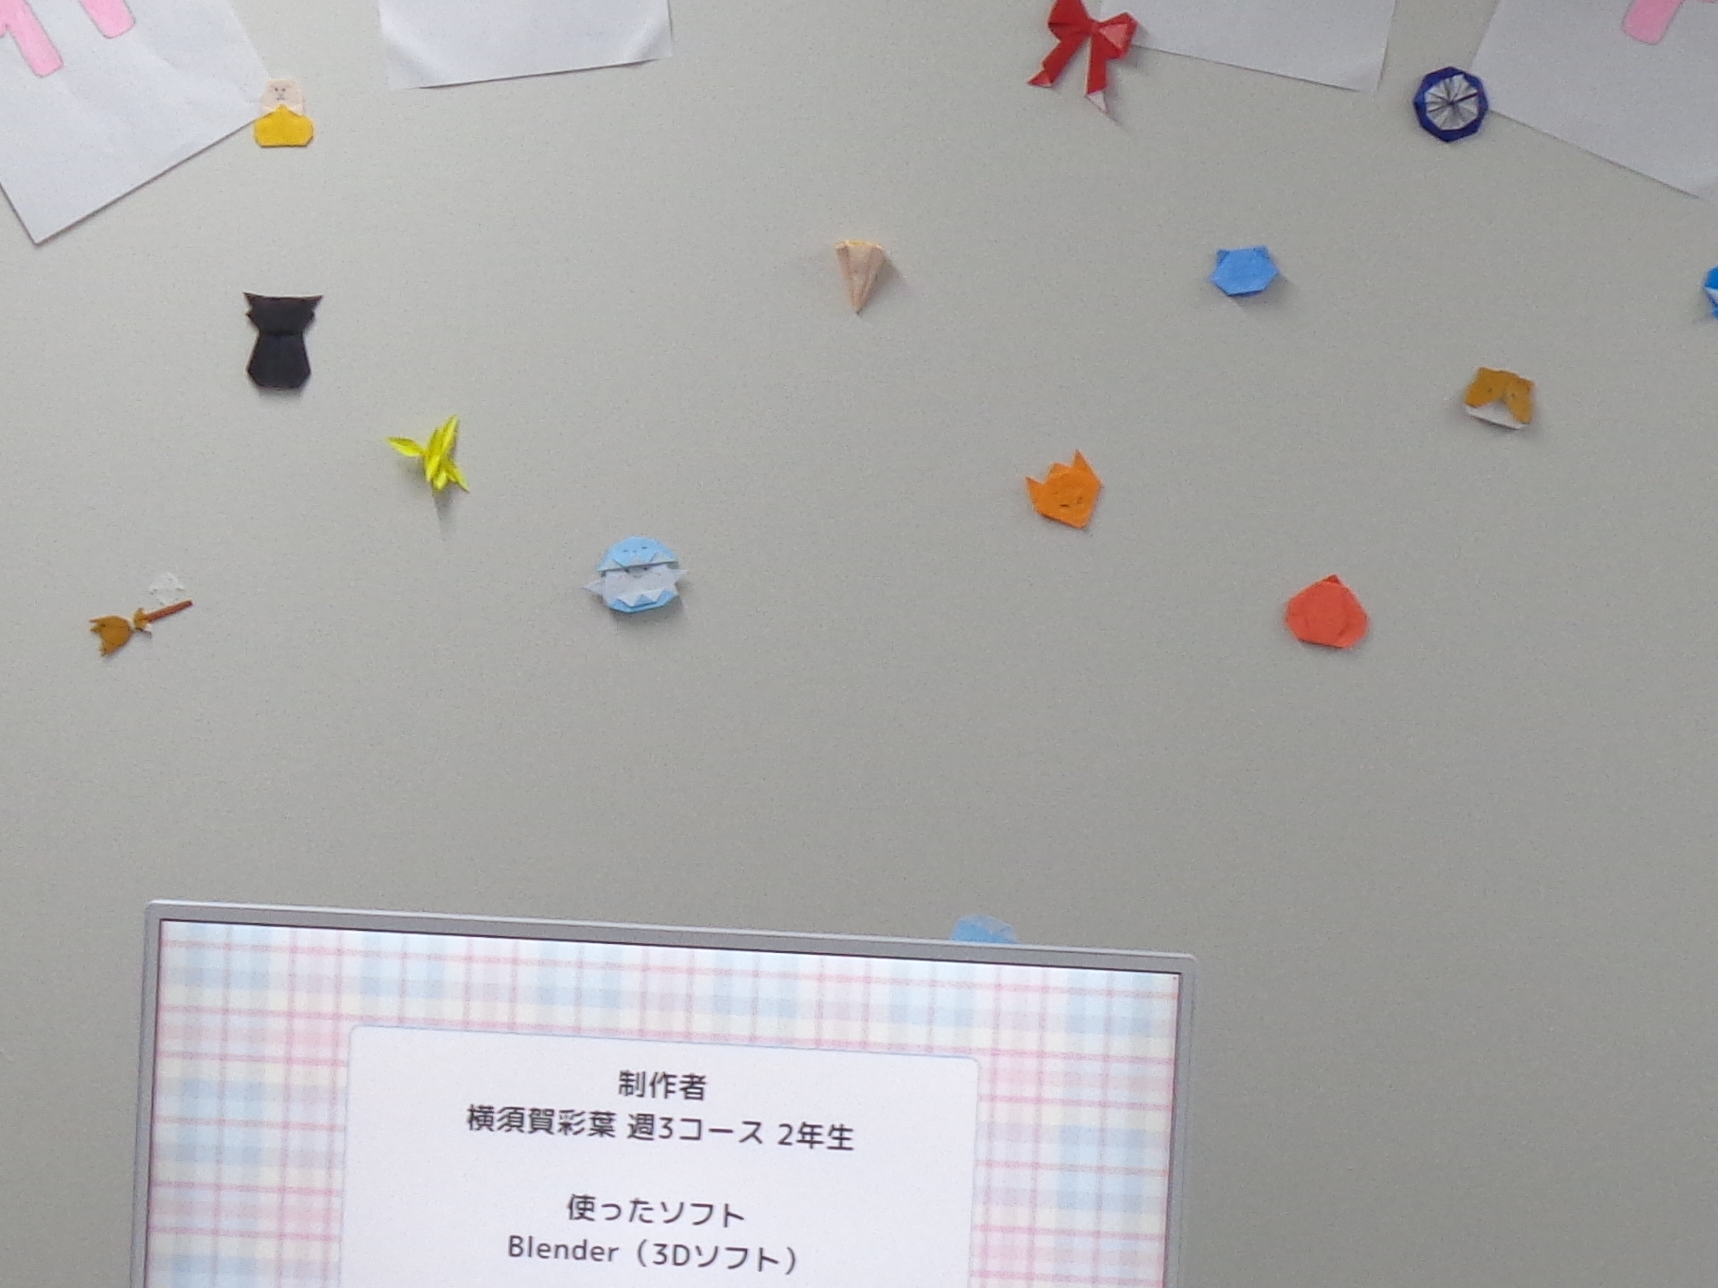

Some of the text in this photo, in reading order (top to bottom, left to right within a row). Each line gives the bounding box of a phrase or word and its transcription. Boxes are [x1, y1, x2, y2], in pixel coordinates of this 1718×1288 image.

[618, 1069, 708, 1102] 制作者
[466, 1103, 855, 1152] 横須賀彩葉 週3コース 2年生
[566, 1193, 746, 1229] 使ったソフト
